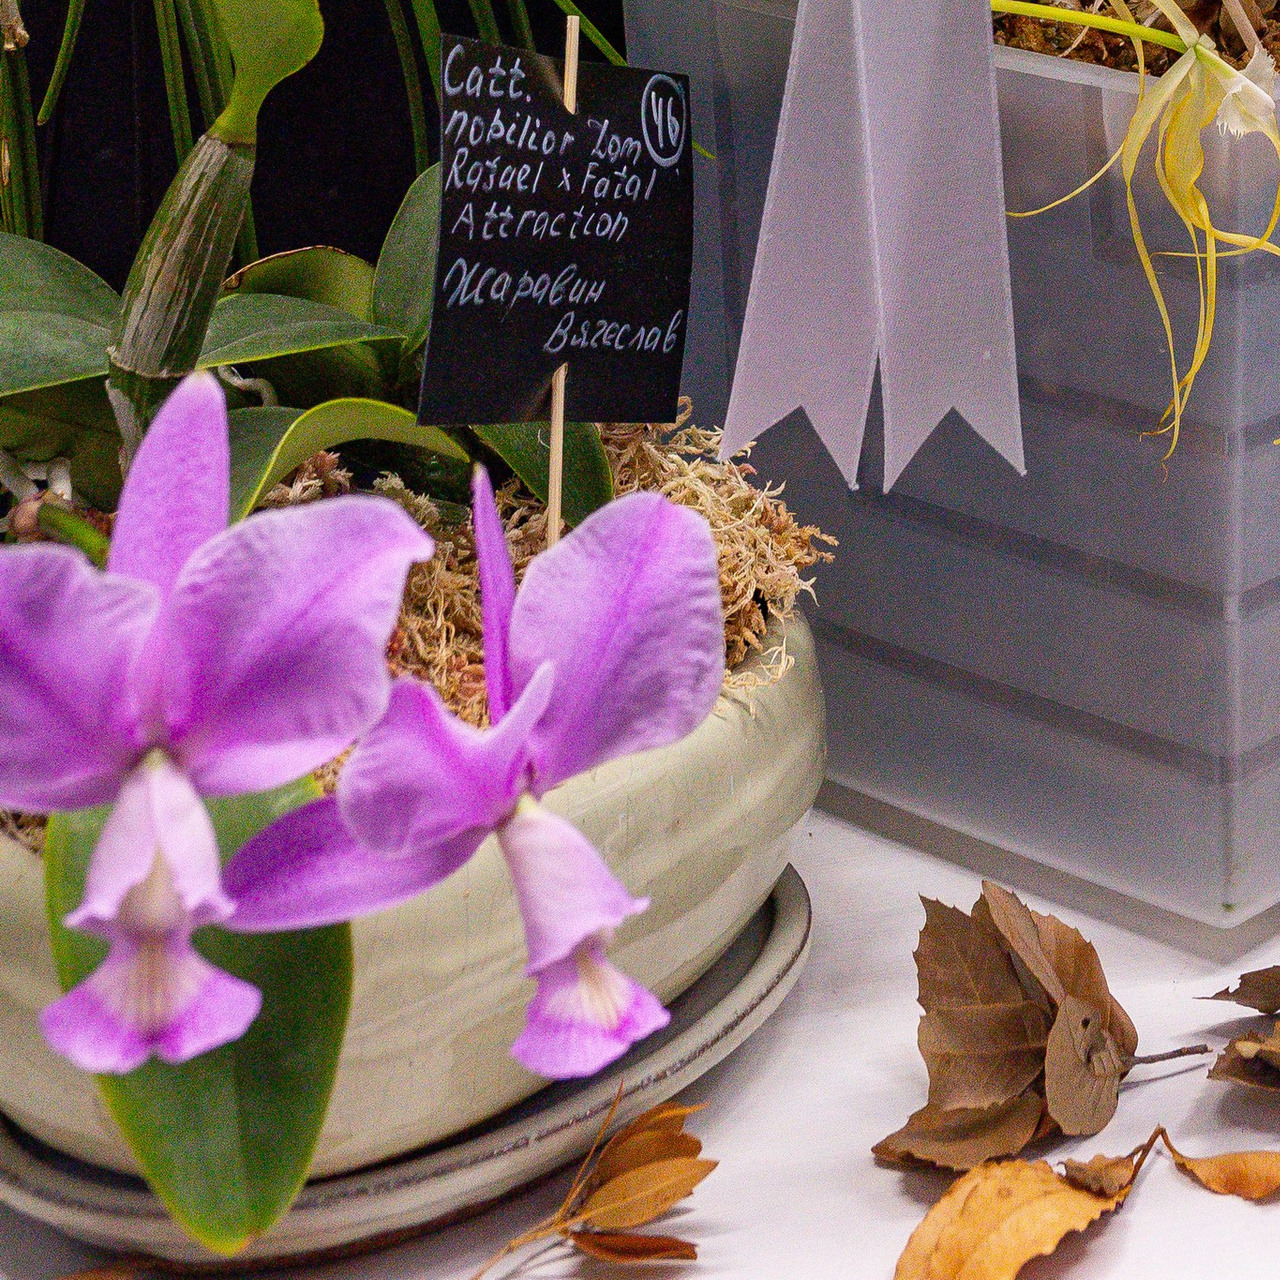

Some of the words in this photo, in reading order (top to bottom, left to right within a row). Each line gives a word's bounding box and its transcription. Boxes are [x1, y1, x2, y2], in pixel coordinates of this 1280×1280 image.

[444, 43, 532, 102] Catt.
[651, 91, 680, 149] 46
[444, 146, 545, 194] Rafael
[580, 161, 657, 201] Fatal
[451, 201, 630, 242] Attraction
